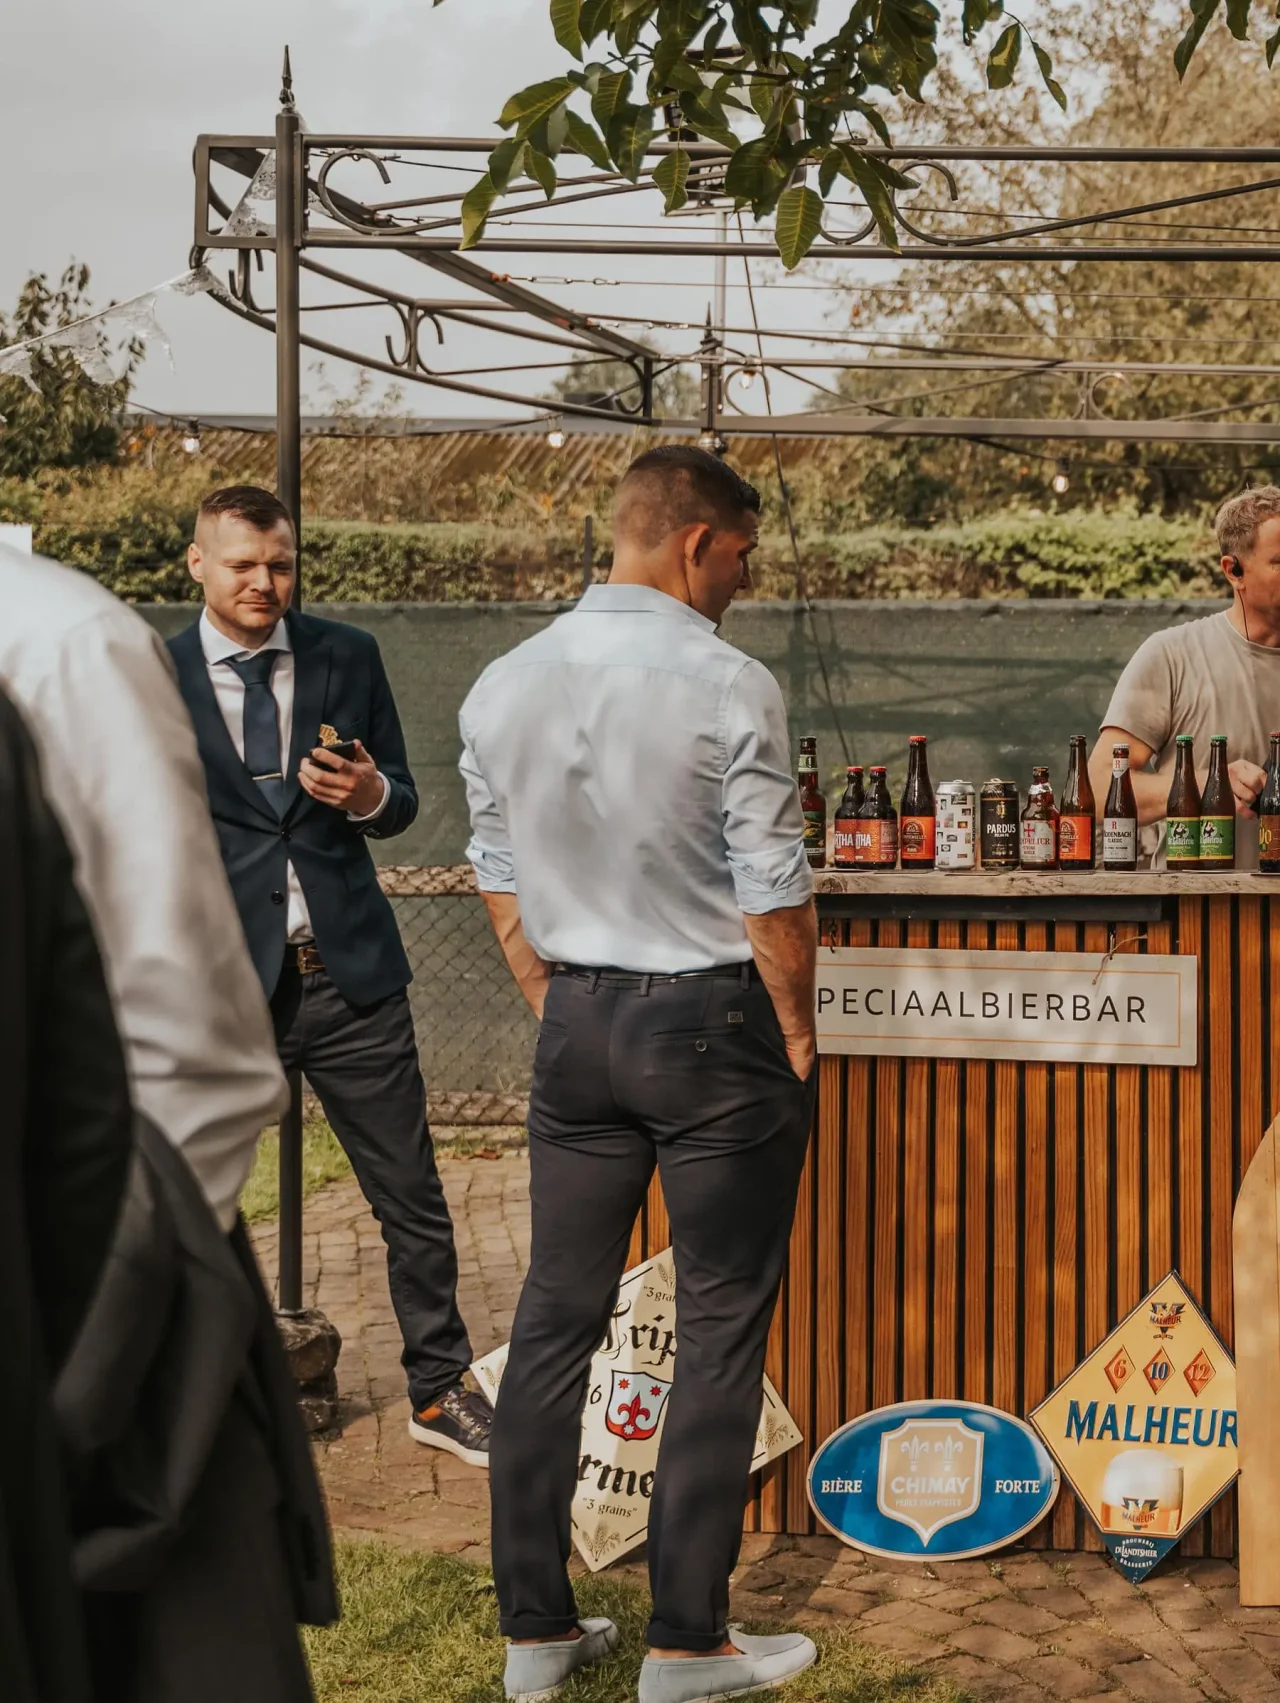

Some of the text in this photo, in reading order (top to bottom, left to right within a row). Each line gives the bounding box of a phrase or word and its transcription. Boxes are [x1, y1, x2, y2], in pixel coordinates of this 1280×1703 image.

[986, 823, 1017, 834] PARDUS
[816, 987, 1147, 1024] PECIAALBIERBAR
[1113, 1359, 1211, 1381] 6 10 12
[1064, 1399, 1239, 1448] MALHEUR
[821, 1476, 1041, 1494] BIÈRE FORTE
[890, 1476, 971, 1495] CHIMAY
